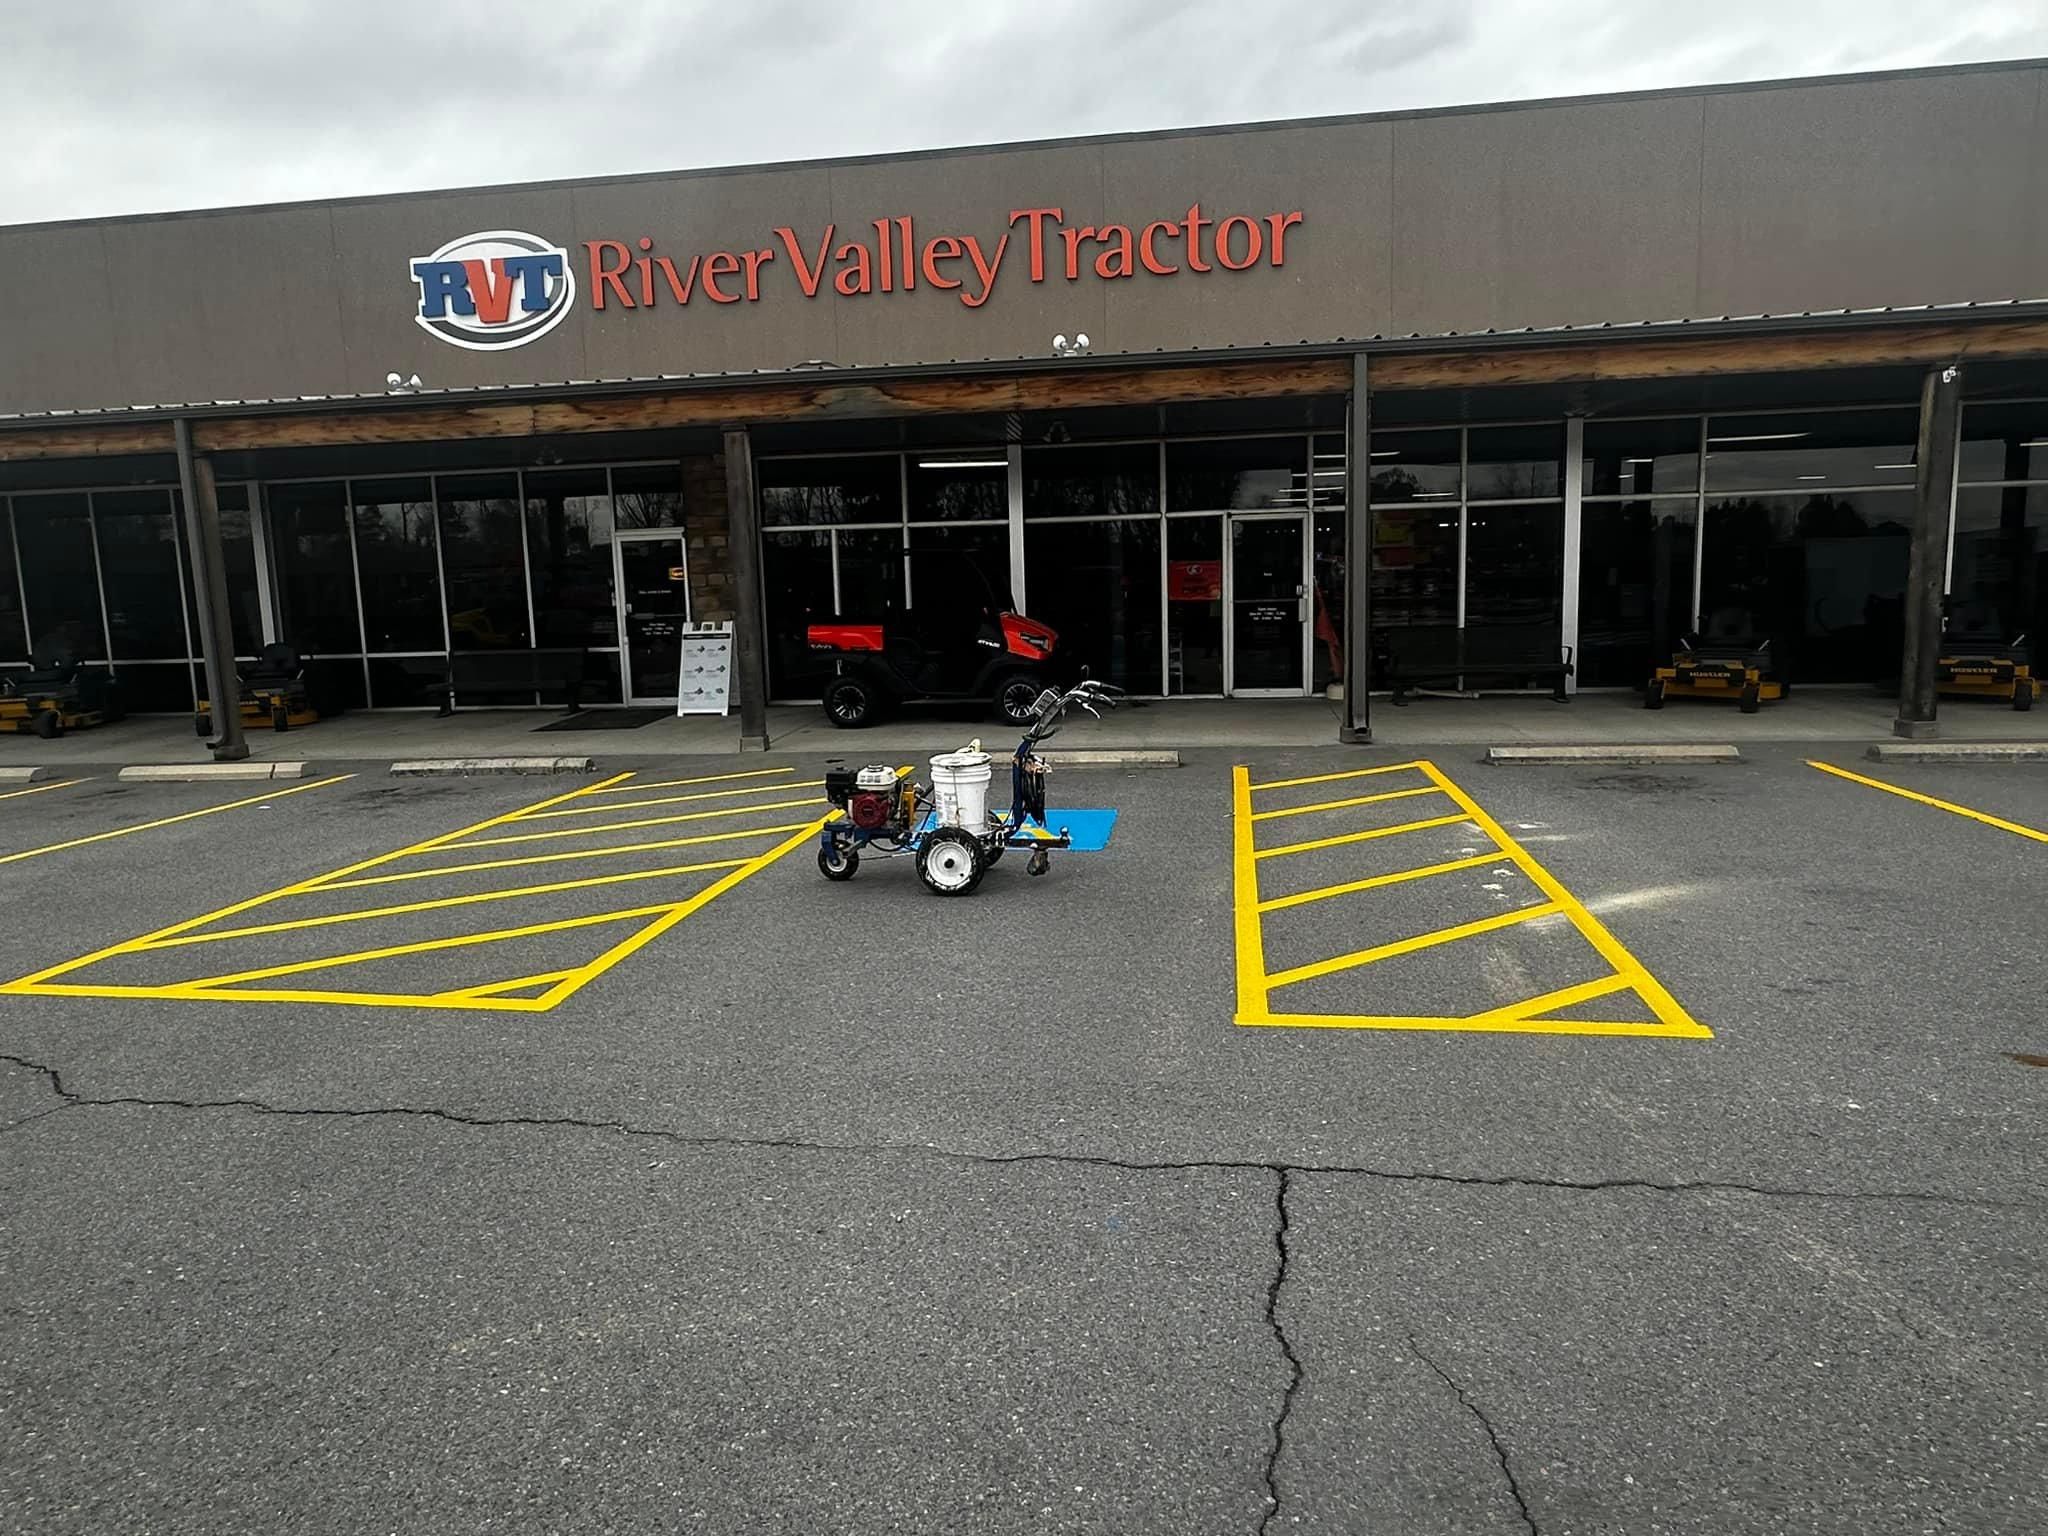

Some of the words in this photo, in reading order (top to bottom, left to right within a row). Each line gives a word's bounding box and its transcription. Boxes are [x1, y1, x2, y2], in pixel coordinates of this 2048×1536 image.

[412, 253, 563, 325] RVT
[582, 238, 774, 310] River
[773, 216, 1009, 308] Valley
[1009, 204, 1303, 282] Tractor
